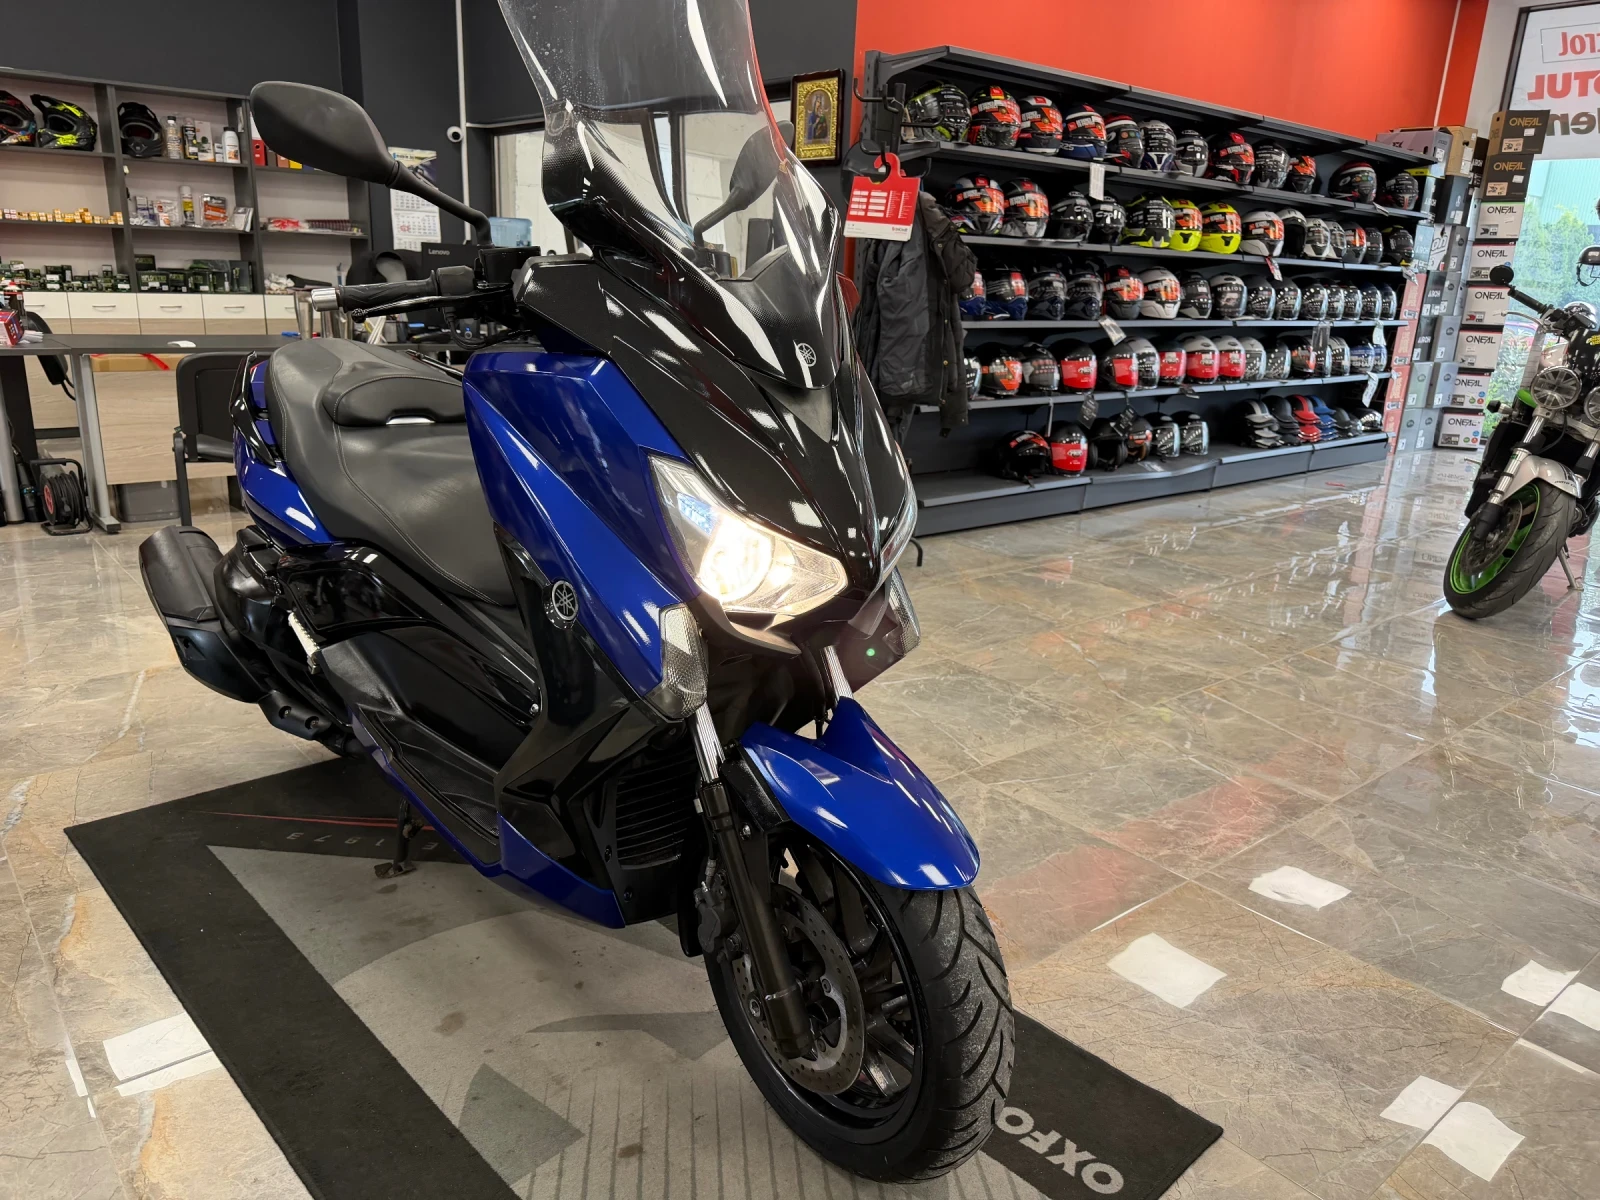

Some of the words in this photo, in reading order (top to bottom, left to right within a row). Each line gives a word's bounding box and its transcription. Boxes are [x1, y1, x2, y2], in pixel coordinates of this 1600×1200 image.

[1509, 117, 1543, 127] ONEAL
[1493, 161, 1527, 171] ONEAL
[1486, 205, 1517, 214] ONEAL
[1477, 249, 1508, 258] ONEAL
[1474, 290, 1505, 300] ONEAL
[1466, 335, 1496, 344] ONEAL
[1448, 417, 1478, 427] ONEAL
[996, 1106, 1124, 1194] OXFO
